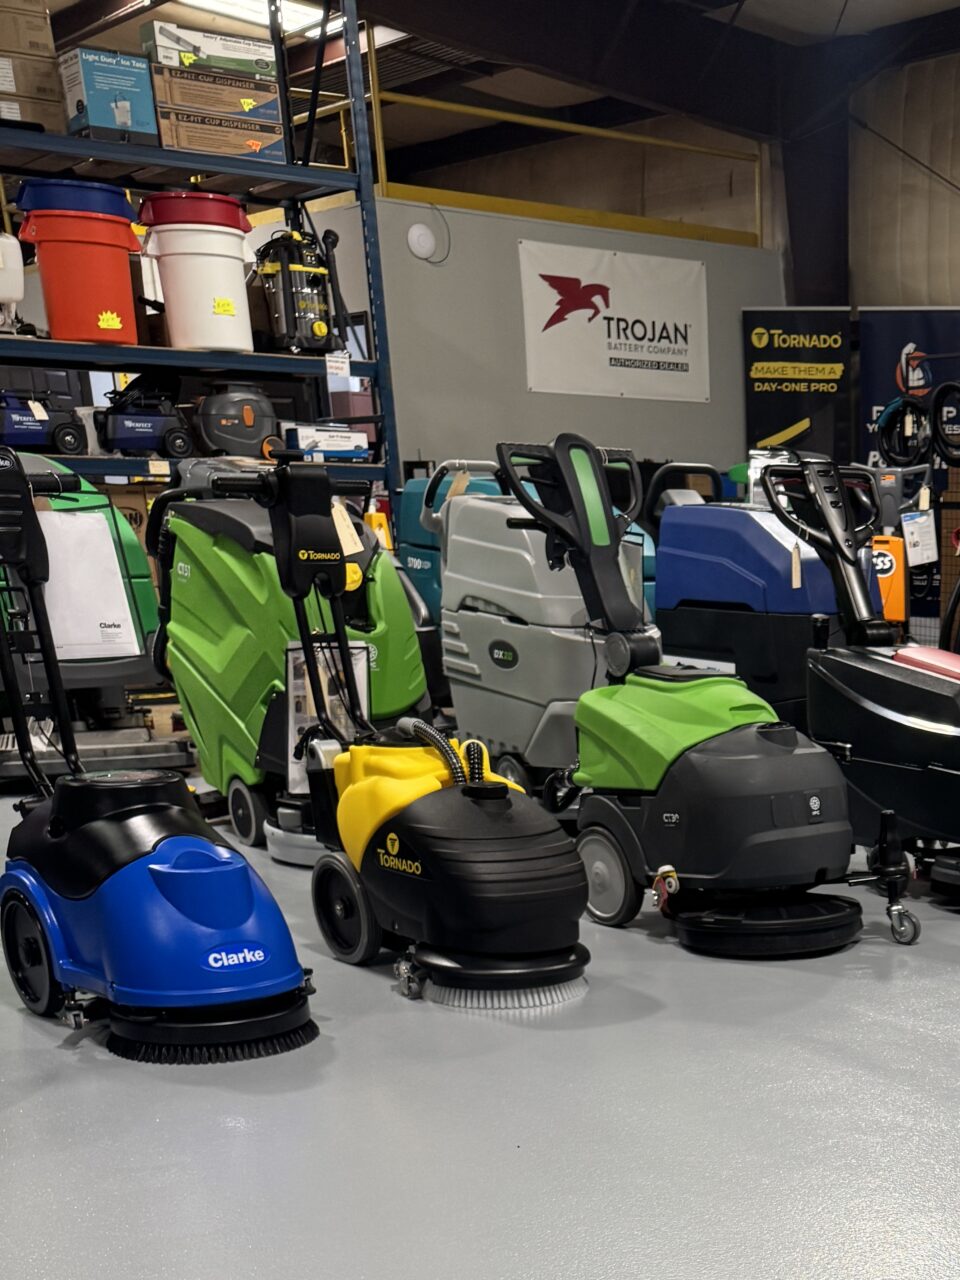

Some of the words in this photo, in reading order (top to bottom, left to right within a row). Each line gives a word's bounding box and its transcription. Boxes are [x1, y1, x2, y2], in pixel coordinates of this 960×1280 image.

[603, 316, 688, 345] TROJAN
[607, 342, 644, 354] BATTERY
[647, 345, 689, 357] COMPANY
[610, 357, 659, 370] AUTHORIZED
[660, 361, 689, 372] DEALER
[754, 365, 788, 376] MAKE
[790, 366, 826, 376] THEM
[828, 366, 838, 376] A
[754, 382, 809, 392] DAY-ONE
[810, 383, 838, 392] PRO
[208, 948, 265, 968] Clarke
